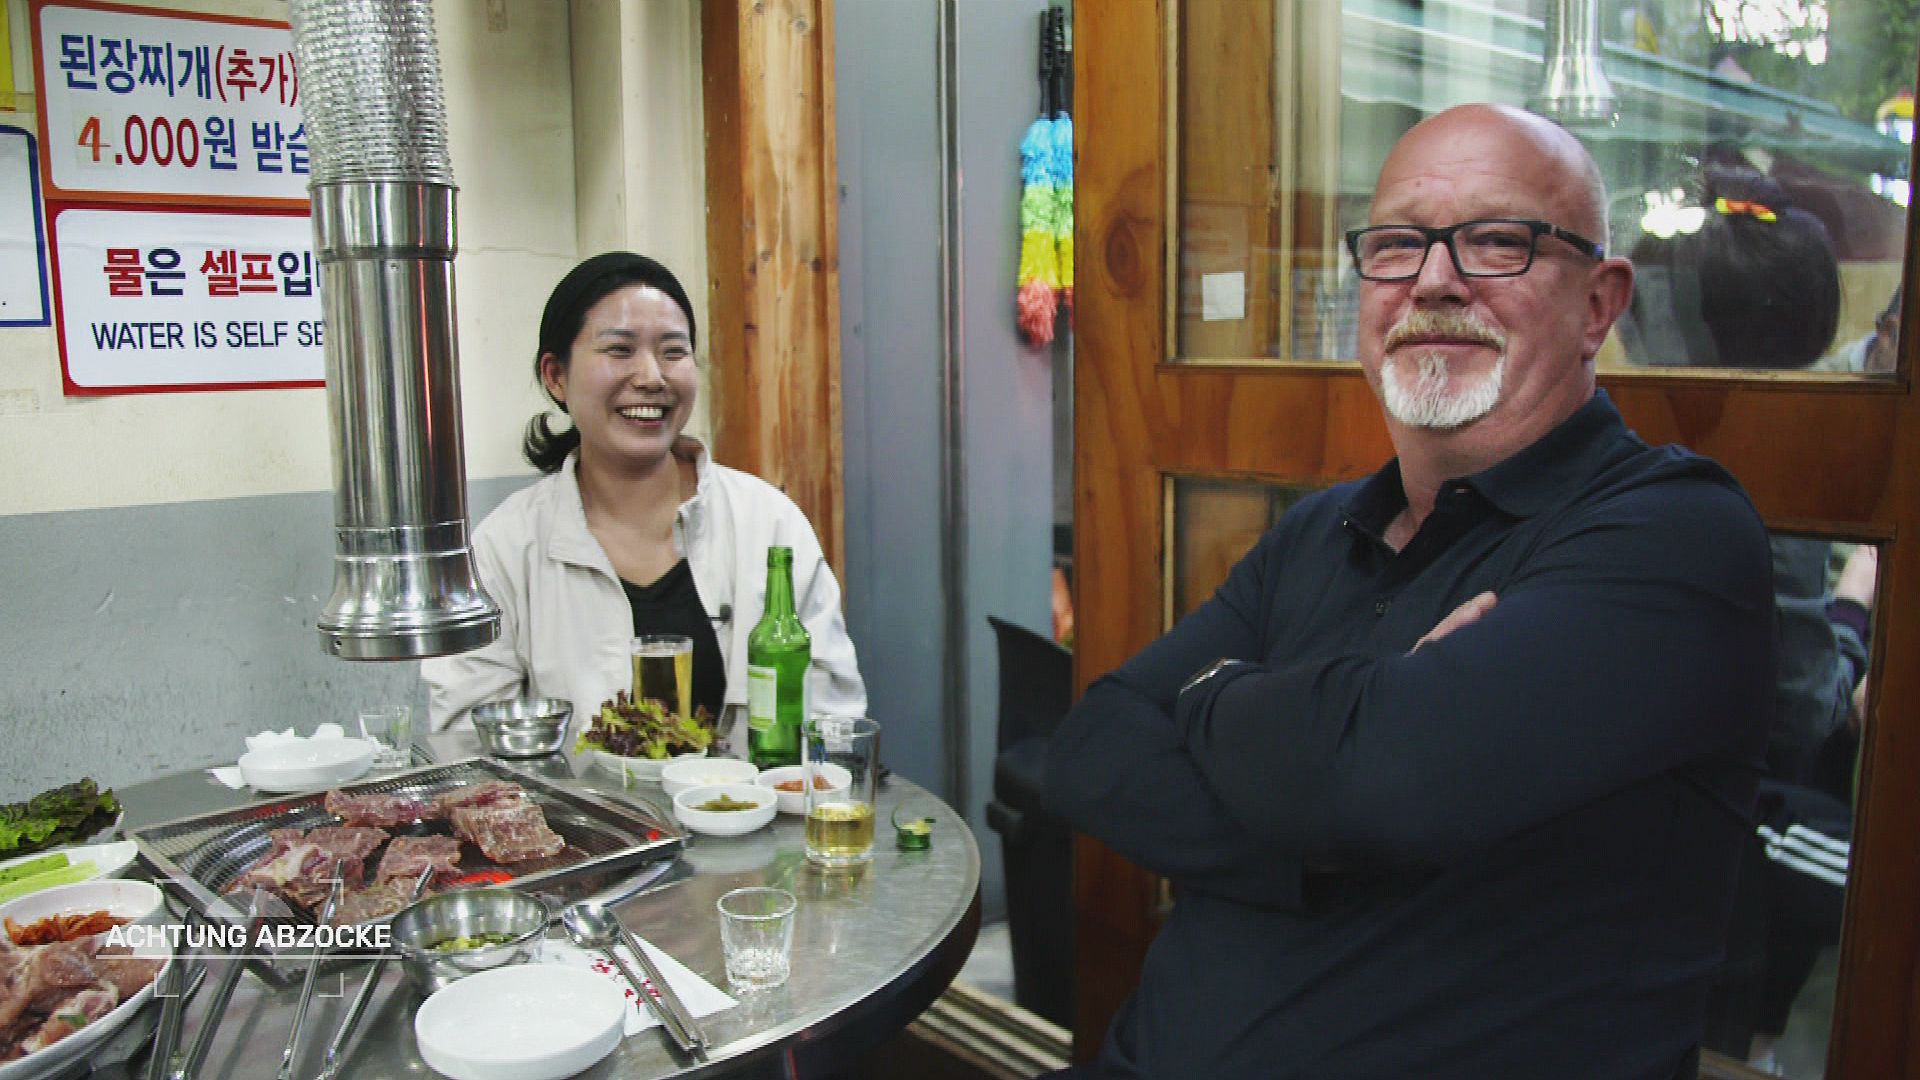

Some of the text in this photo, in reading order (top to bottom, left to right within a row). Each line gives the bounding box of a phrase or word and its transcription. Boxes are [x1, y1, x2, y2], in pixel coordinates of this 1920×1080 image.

[60, 34, 299, 107] 된장찌개(추가)
[78, 114, 238, 171] 4.000원
[104, 248, 321, 298] 물은 셀프입
[91, 322, 185, 350] WATER
[194, 320, 218, 349] IS
[226, 320, 289, 349] SELF
